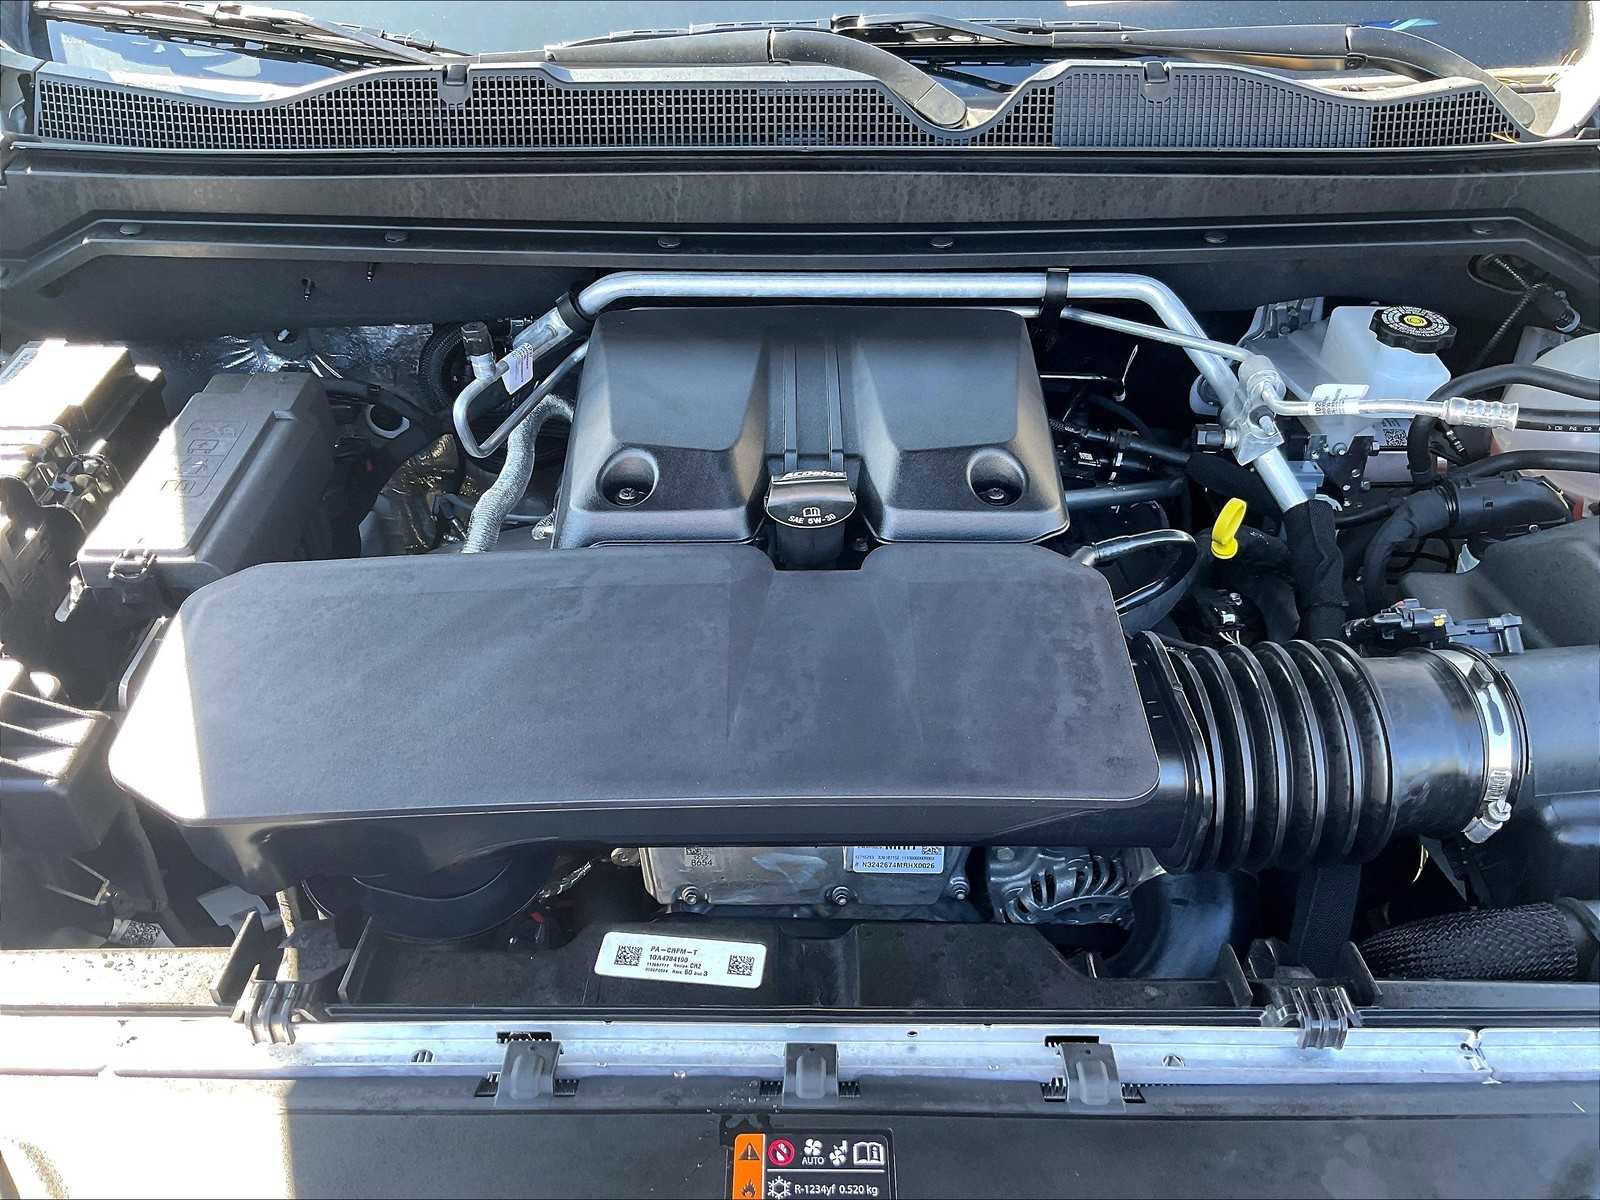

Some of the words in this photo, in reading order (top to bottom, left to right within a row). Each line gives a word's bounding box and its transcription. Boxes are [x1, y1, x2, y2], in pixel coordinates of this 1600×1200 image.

[788, 515, 804, 524] SAE
[801, 1156, 825, 1166] AUTO
[794, 1183, 836, 1197] R-1234yf
[839, 1184, 865, 1194] 0.520
[866, 1184, 879, 1197] kg
